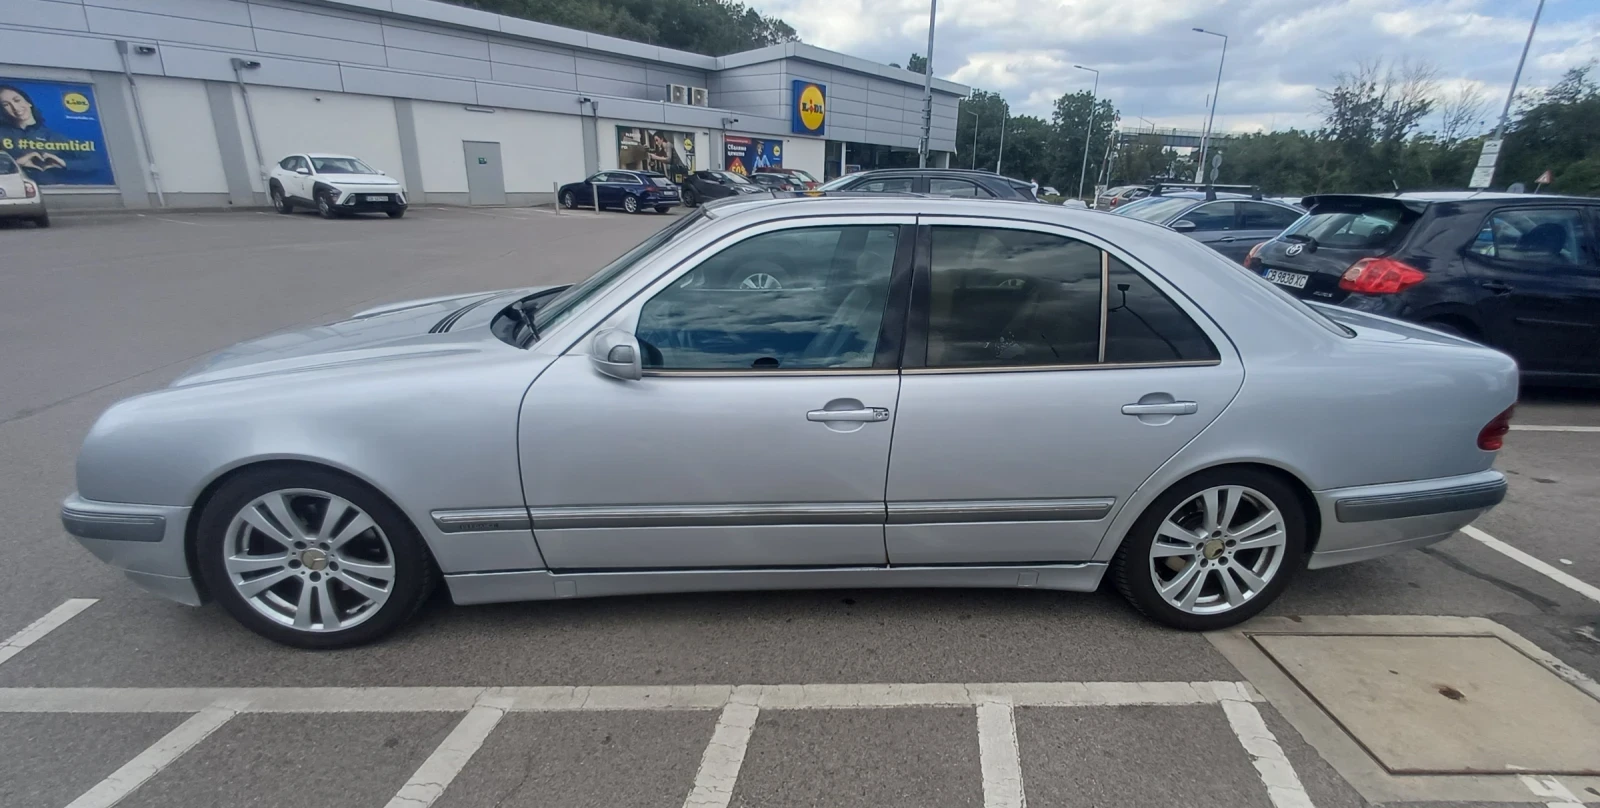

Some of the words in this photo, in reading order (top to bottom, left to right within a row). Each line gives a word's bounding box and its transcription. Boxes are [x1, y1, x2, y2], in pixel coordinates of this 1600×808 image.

[18, 139, 95, 151] #teamlidl
[1267, 269, 1277, 281] CB
[1277, 271, 1295, 285] 9838
[1294, 275, 1307, 287] XC
